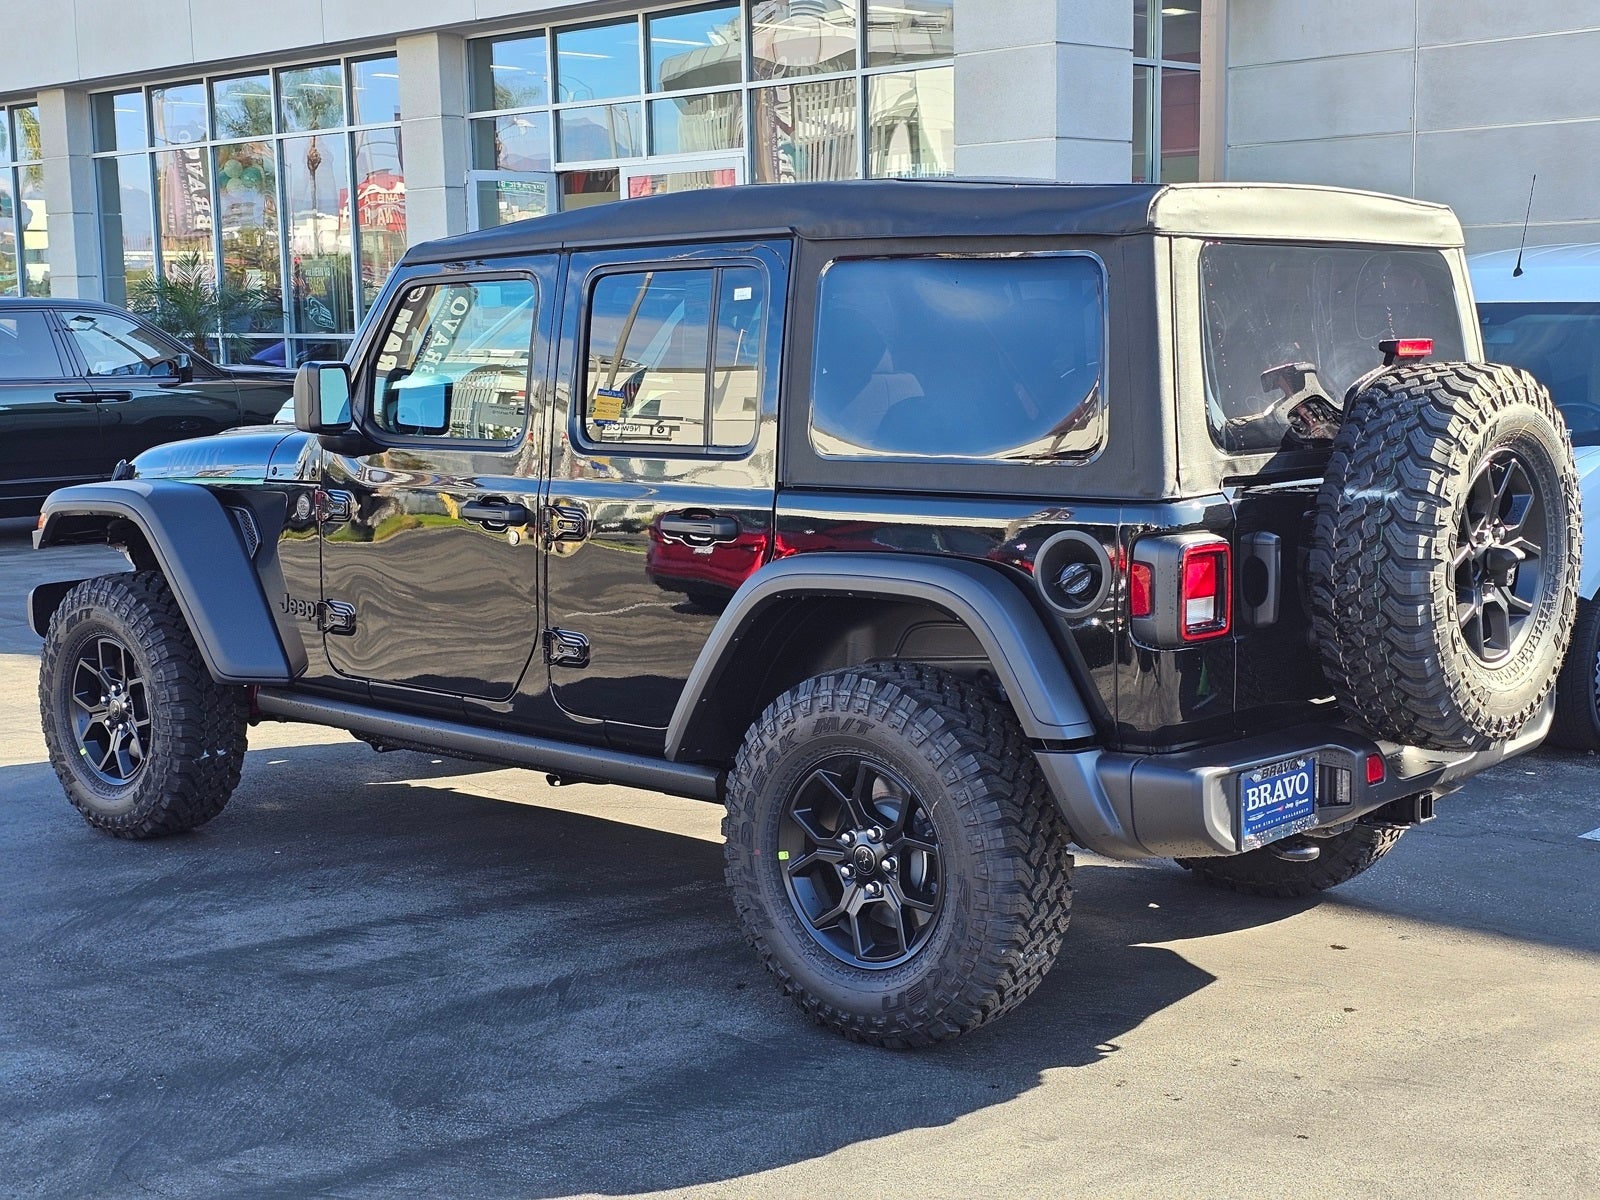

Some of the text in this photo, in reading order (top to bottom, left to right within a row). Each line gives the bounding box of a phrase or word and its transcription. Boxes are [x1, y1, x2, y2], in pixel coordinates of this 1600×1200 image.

[279, 593, 317, 618] Jeep
[812, 716, 876, 737] M/T
[1246, 772, 1309, 812] BRAVO
